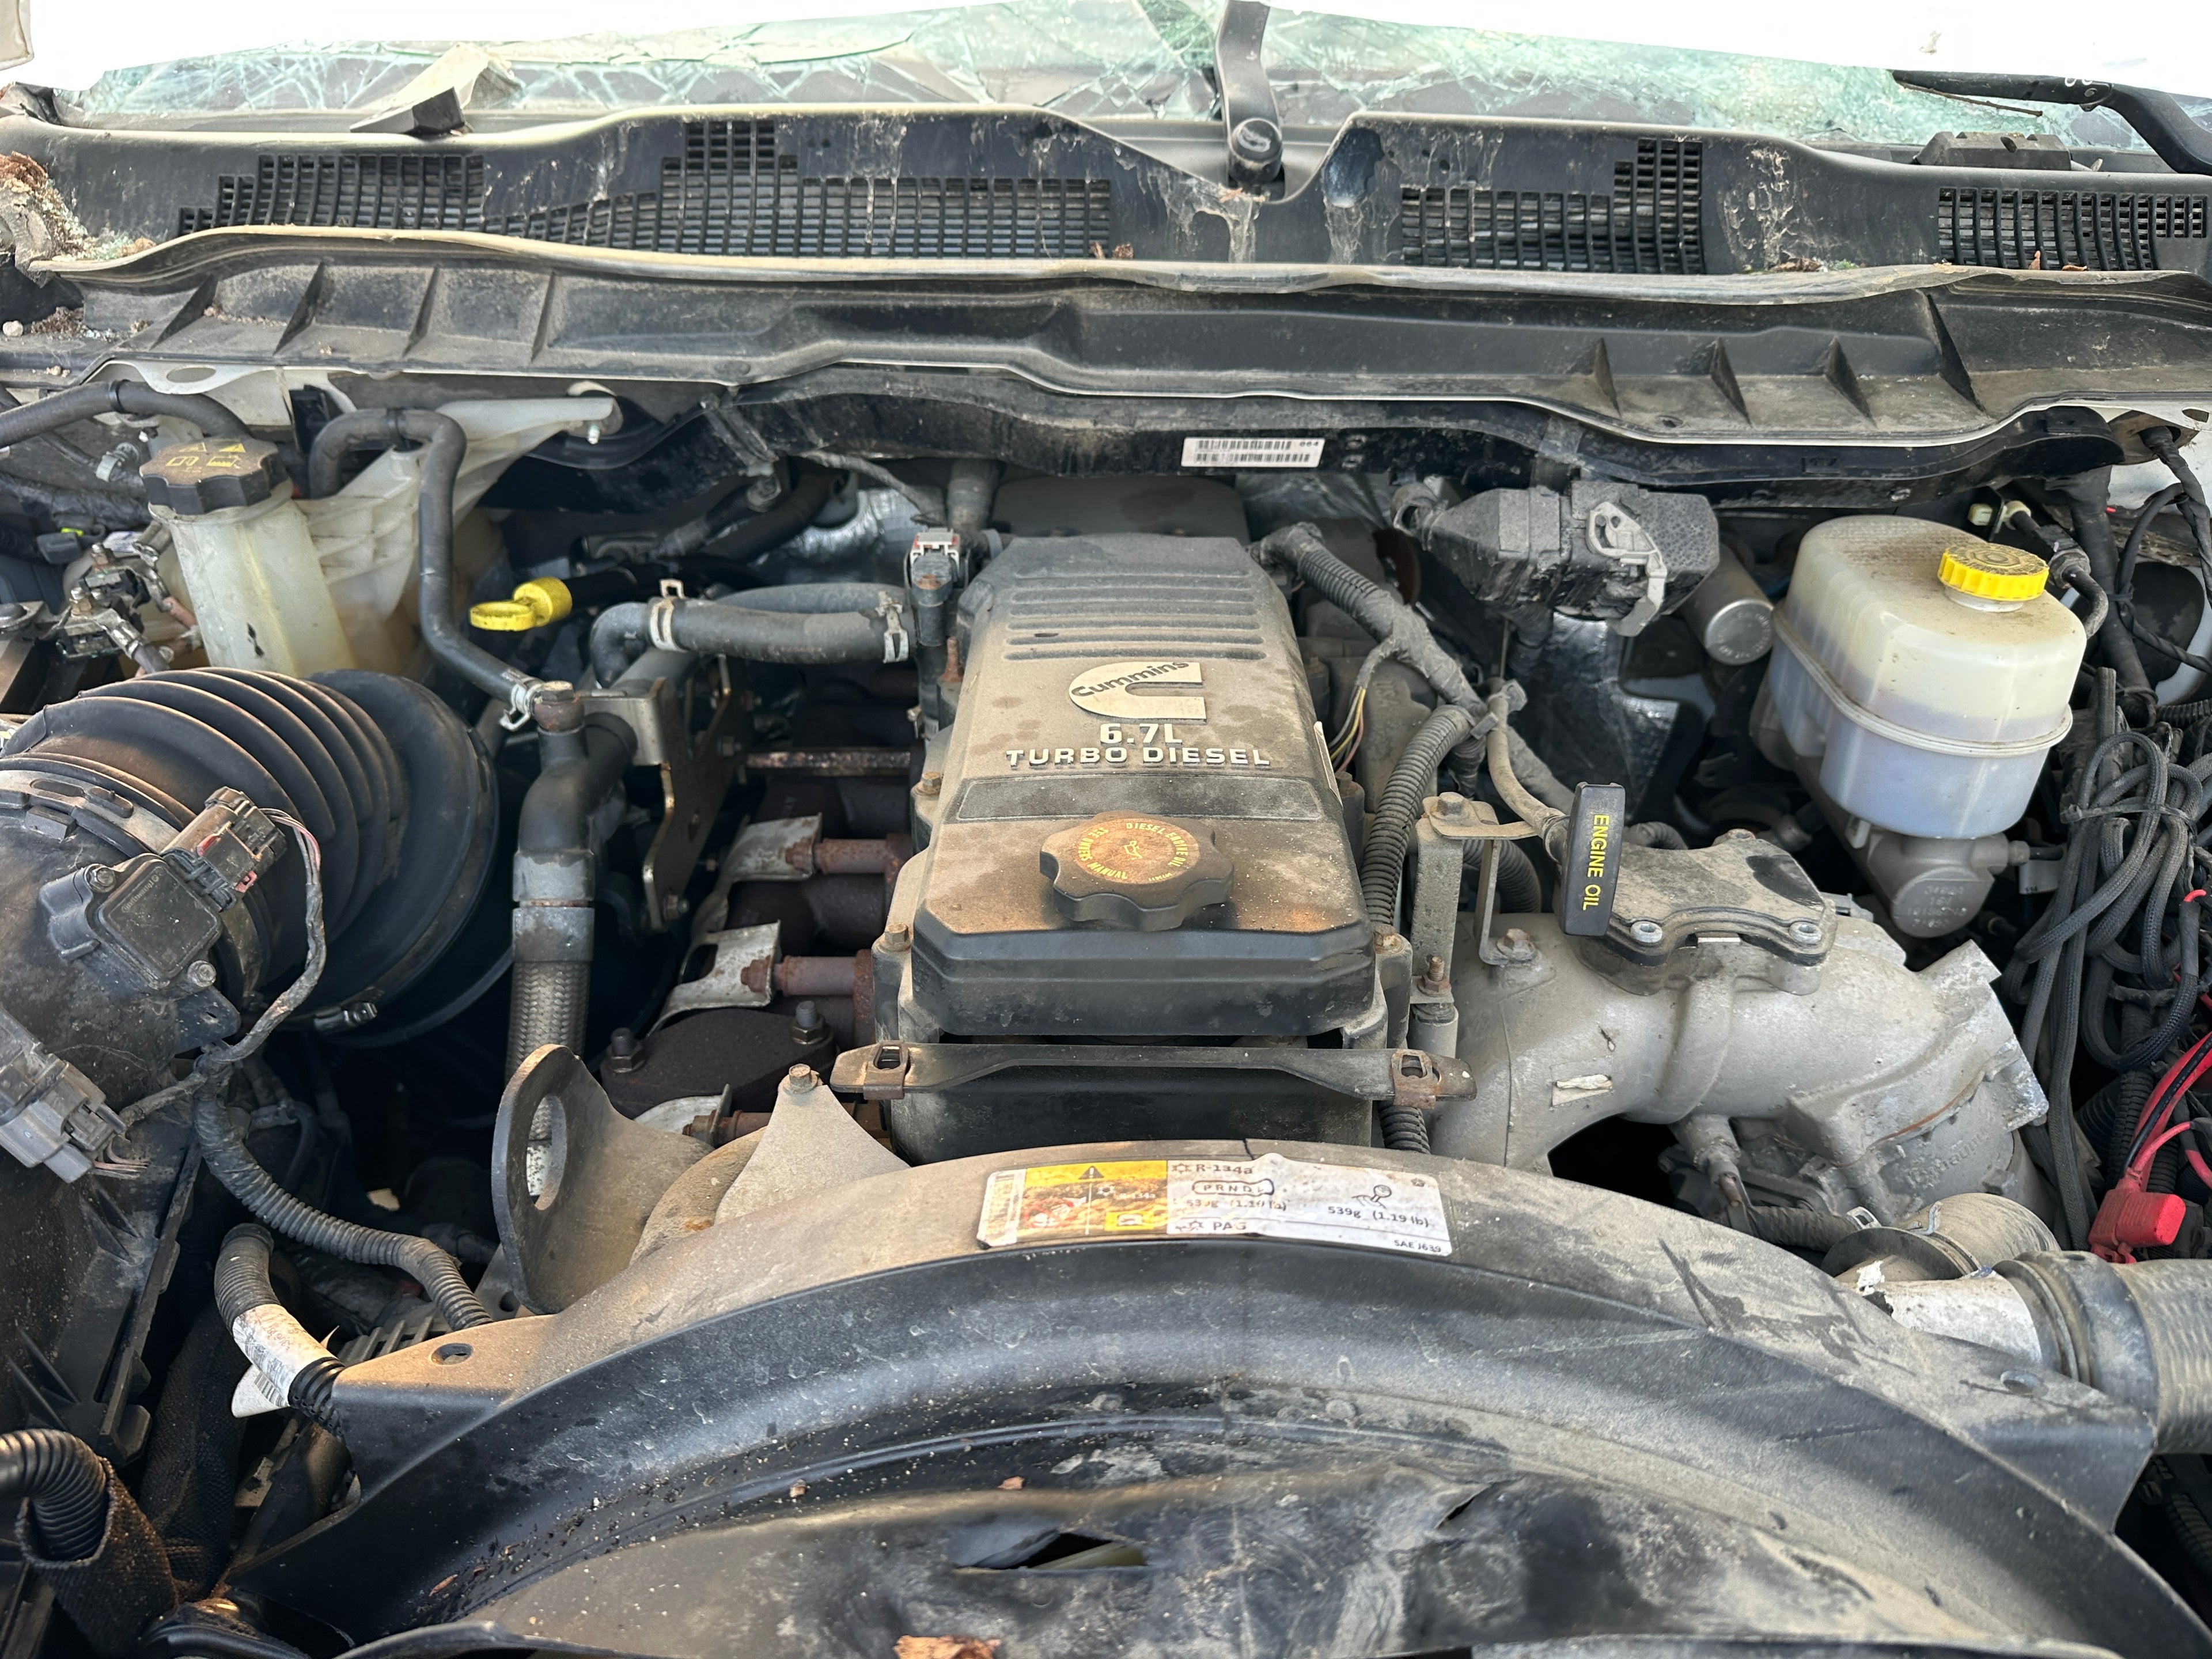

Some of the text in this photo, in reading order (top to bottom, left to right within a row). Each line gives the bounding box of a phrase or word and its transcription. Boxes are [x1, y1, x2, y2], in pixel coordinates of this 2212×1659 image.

[1071, 662, 1190, 696] Cummins
[1100, 723, 1183, 744] 6.7L
[1006, 747, 1270, 767] TURBO DIESEL
[1088, 827, 1109, 839] SEE
[1126, 822, 1188, 867] DIESEL ENGINE OIL
[1086, 862, 1128, 880] MANUAL
[1582, 814, 1610, 911] ENGINE OIL
[1196, 1164, 1253, 1174] R-134a
[1328, 1206, 1361, 1218] 539g
[1373, 1210, 1407, 1222] (1.19
[1213, 1221, 1247, 1231] PAG
[1394, 1240, 1415, 1249] SAE
